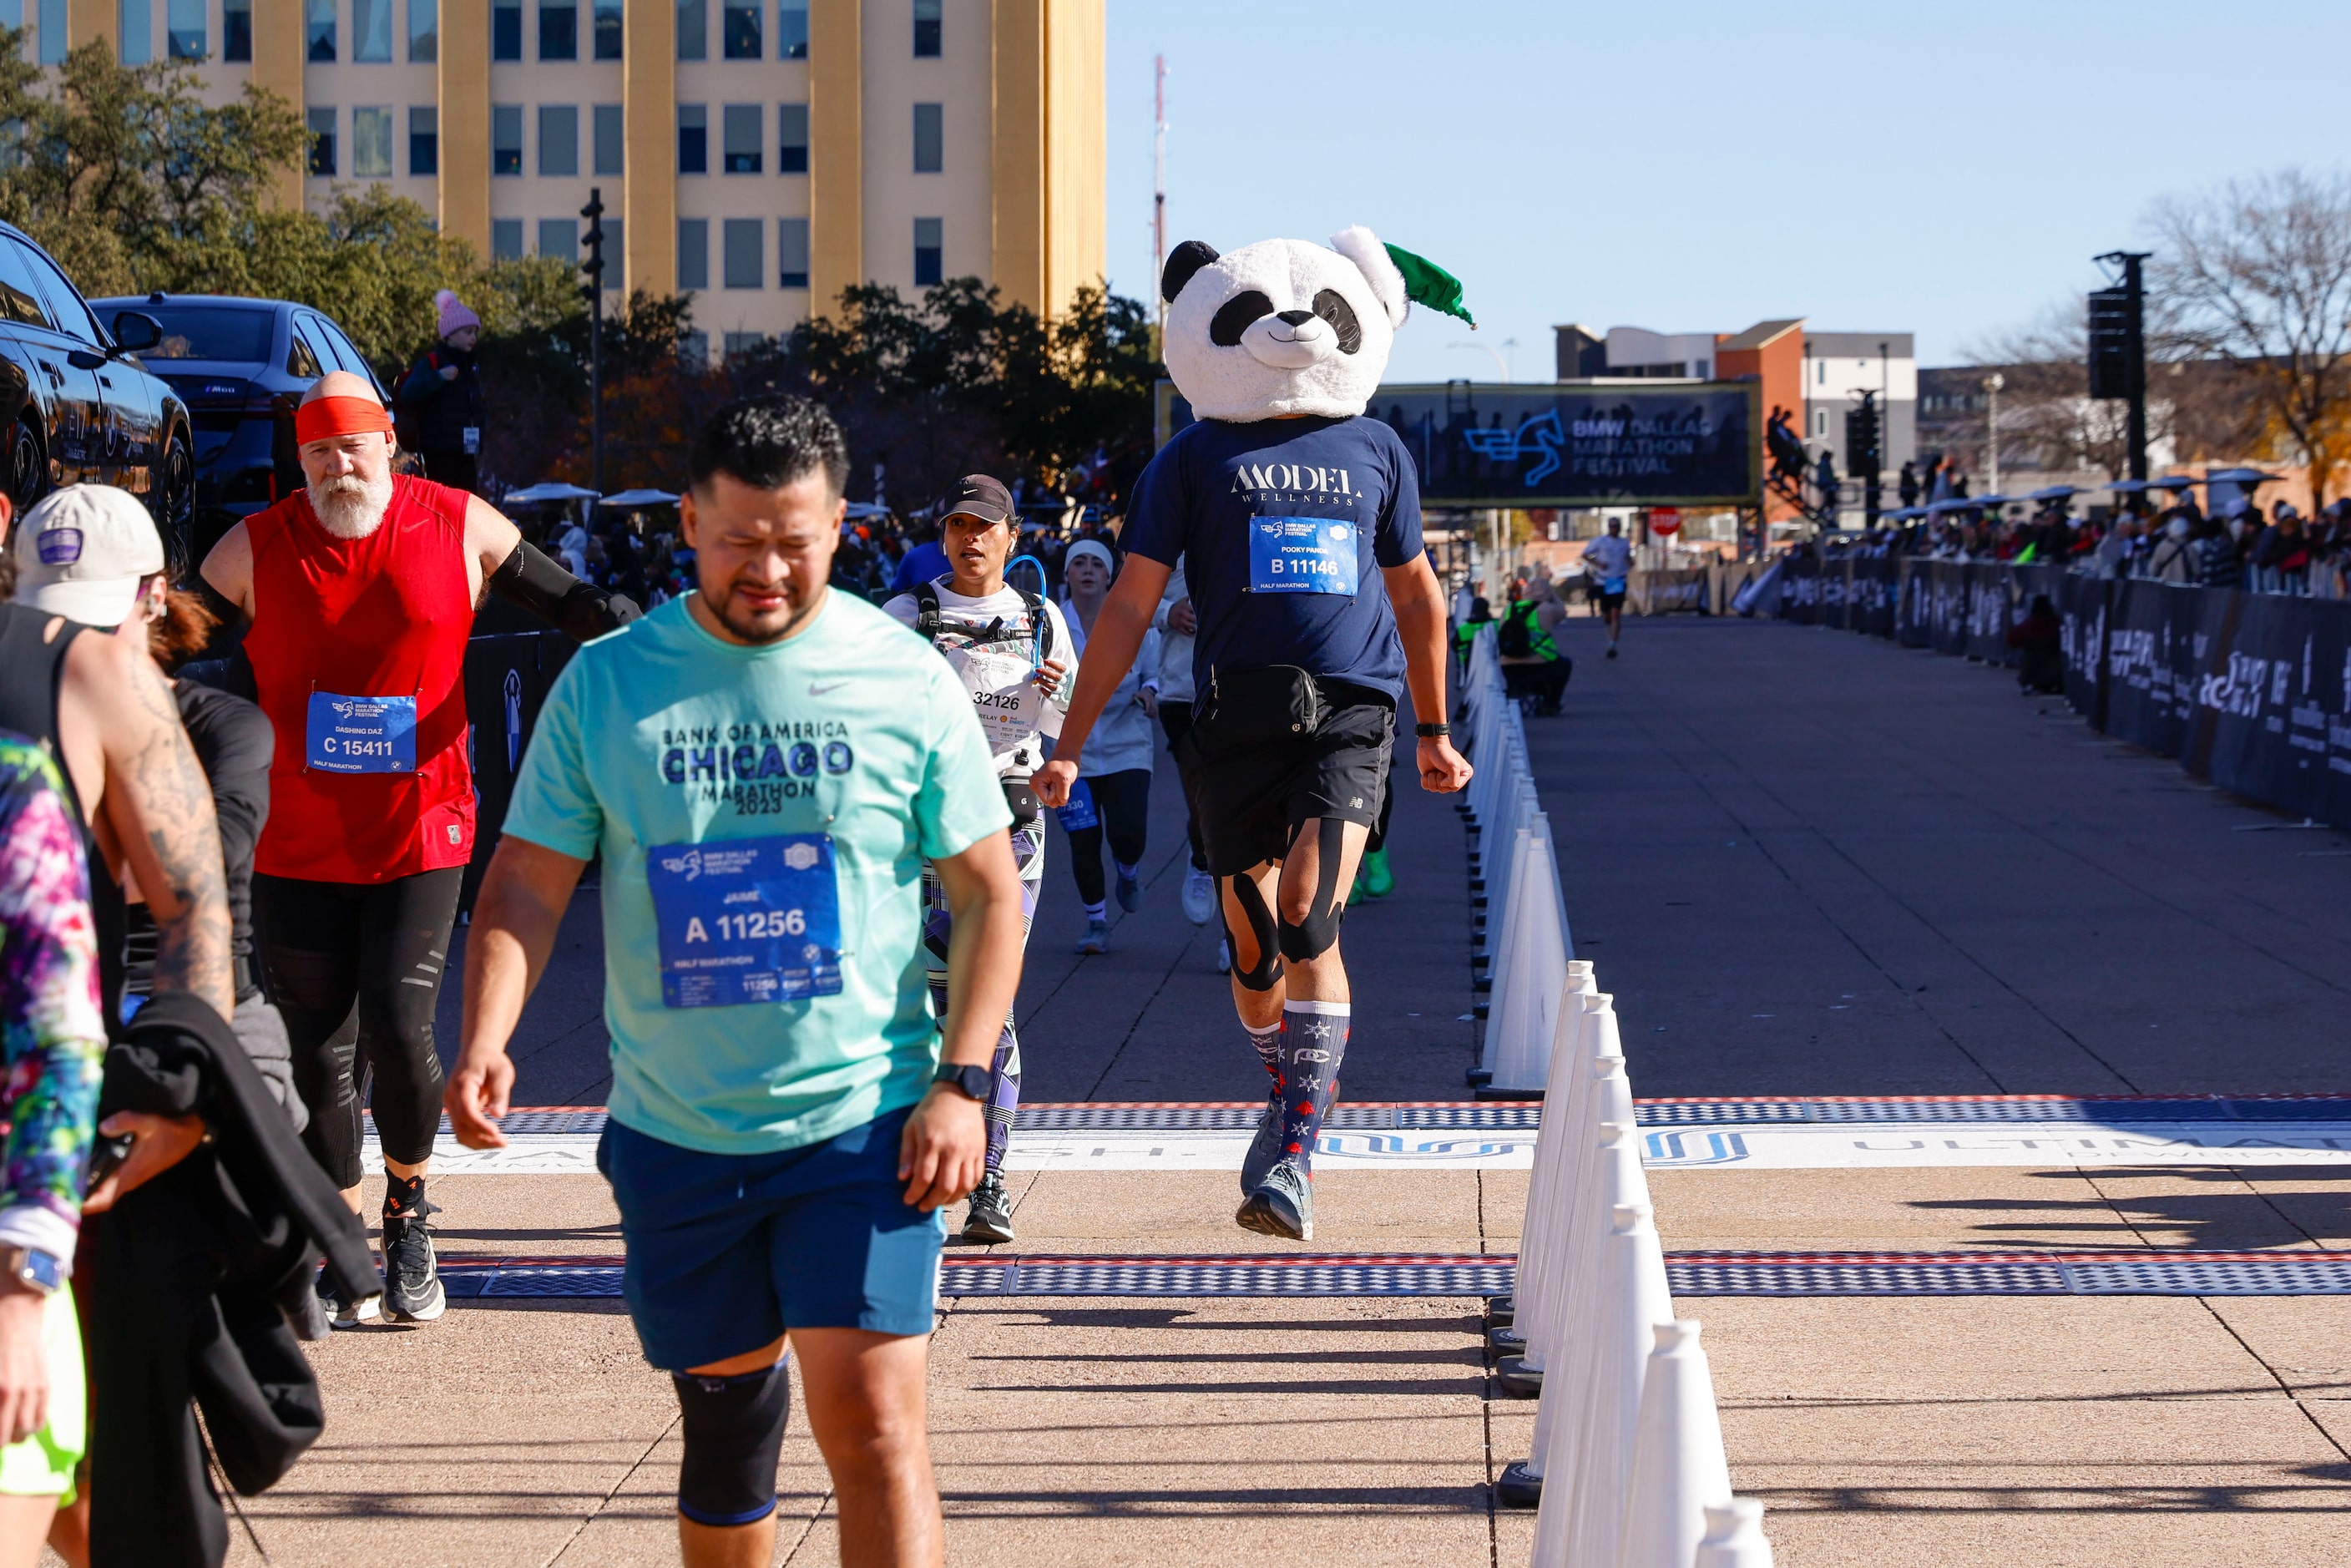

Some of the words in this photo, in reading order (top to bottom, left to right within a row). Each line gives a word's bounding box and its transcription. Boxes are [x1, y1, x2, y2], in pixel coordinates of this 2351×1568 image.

[1573, 419, 1625, 438] BMW
[1631, 418, 1712, 436] DALLAS
[1573, 438, 1694, 454] MARATHON
[1573, 458, 1673, 477] FESTIVAL
[1231, 463, 1363, 498] MODEL
[1242, 493, 1353, 507] WELLNESS
[1651, 513, 1679, 527] STOP
[1272, 559, 1285, 574] B
[1290, 559, 1339, 575] 11146
[973, 691, 1019, 711] 32126
[336, 726, 367, 734] DASHING
[663, 727, 718, 745] BANK
[727, 726, 751, 741] OF
[760, 722, 848, 740] AMERICA
[324, 737, 336, 753] C
[342, 740, 393, 756] 15411
[662, 741, 854, 784] CHICAGO
[702, 781, 816, 801] MARATHON
[736, 798, 783, 816] 2023
[724, 891, 761, 903] JAIME
[685, 917, 709, 943] A
[716, 909, 806, 940] 11256
[674, 959, 697, 969] HALF
[698, 955, 754, 967] MARATHON
